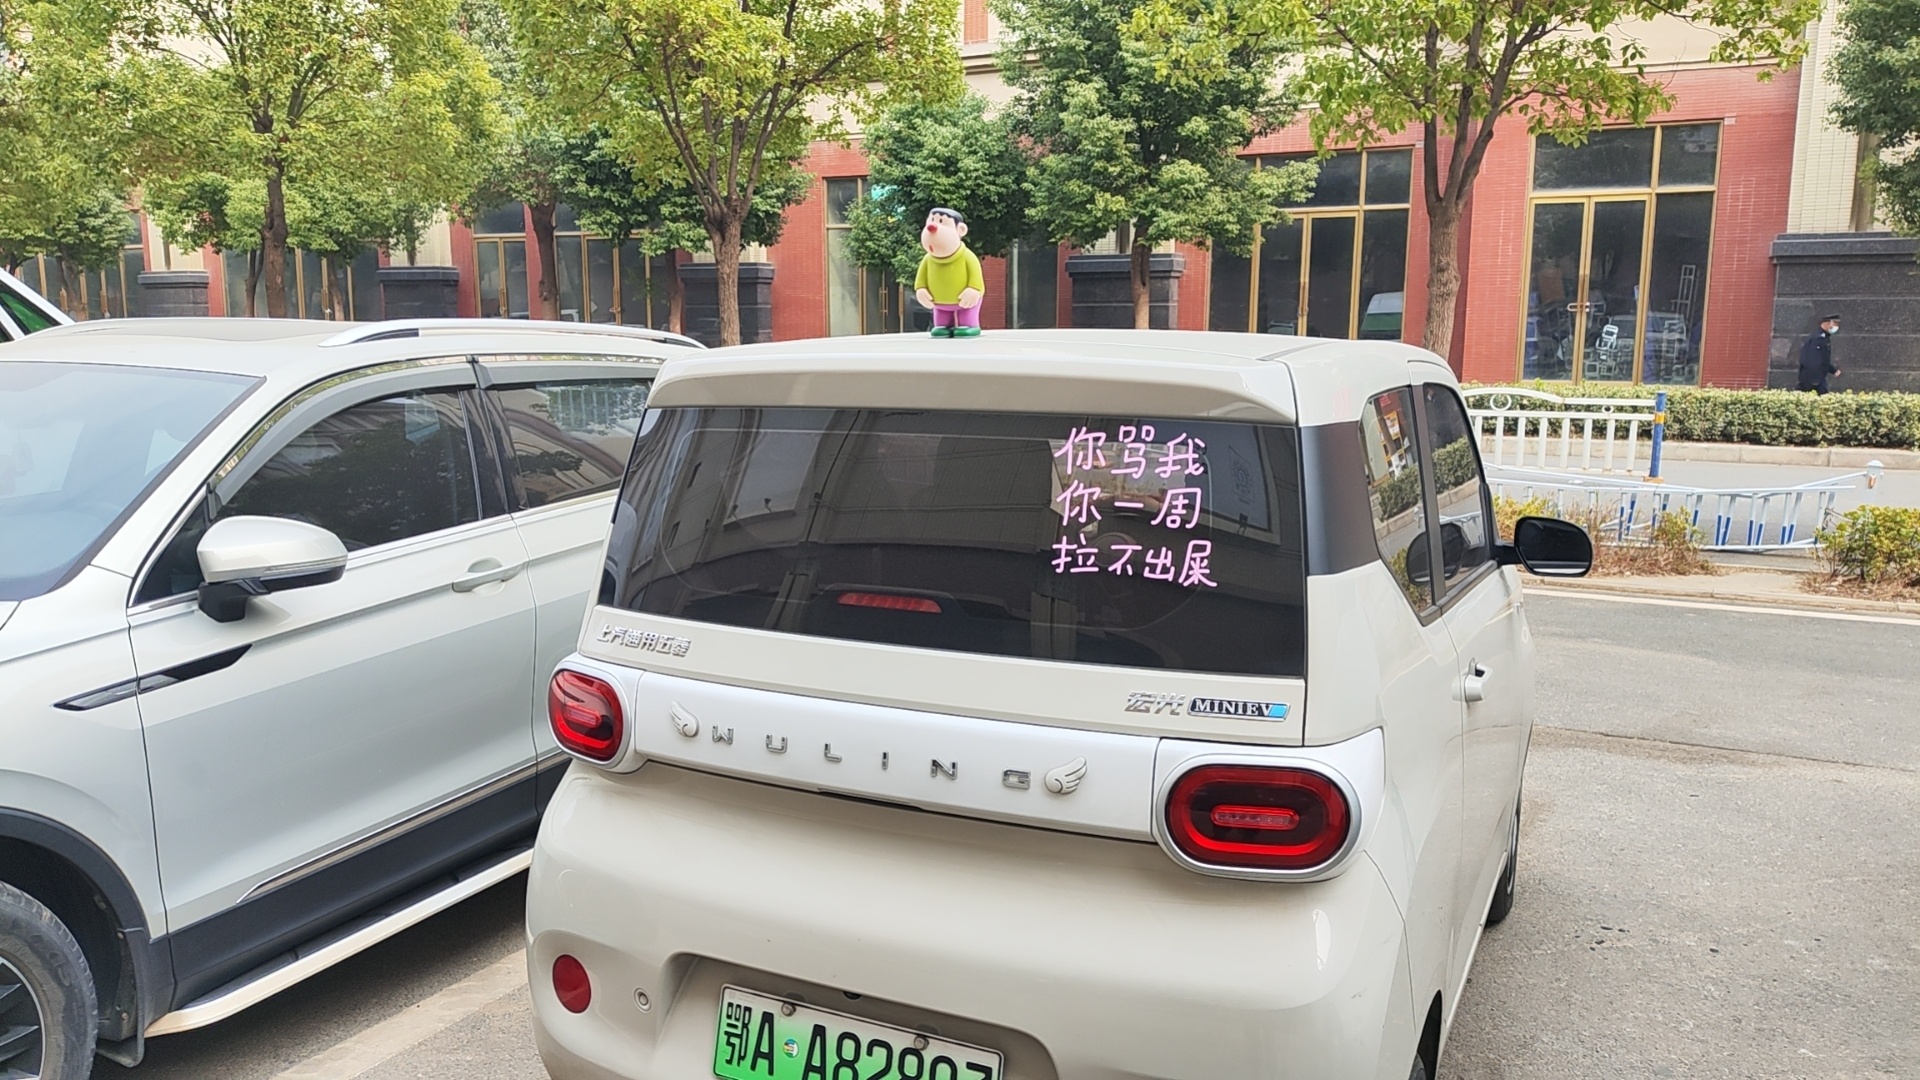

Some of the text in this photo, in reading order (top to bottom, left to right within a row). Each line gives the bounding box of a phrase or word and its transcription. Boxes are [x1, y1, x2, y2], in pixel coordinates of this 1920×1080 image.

[1054, 425, 1206, 479] 你骂我
[1056, 480, 1203, 529] 你一周
[1051, 533, 1218, 587] 拉不出屎
[596, 623, 692, 658] 上汽通用五菱
[1124, 690, 1274, 717] 宏光 MINIEV
[711, 724, 1032, 791] WULING
